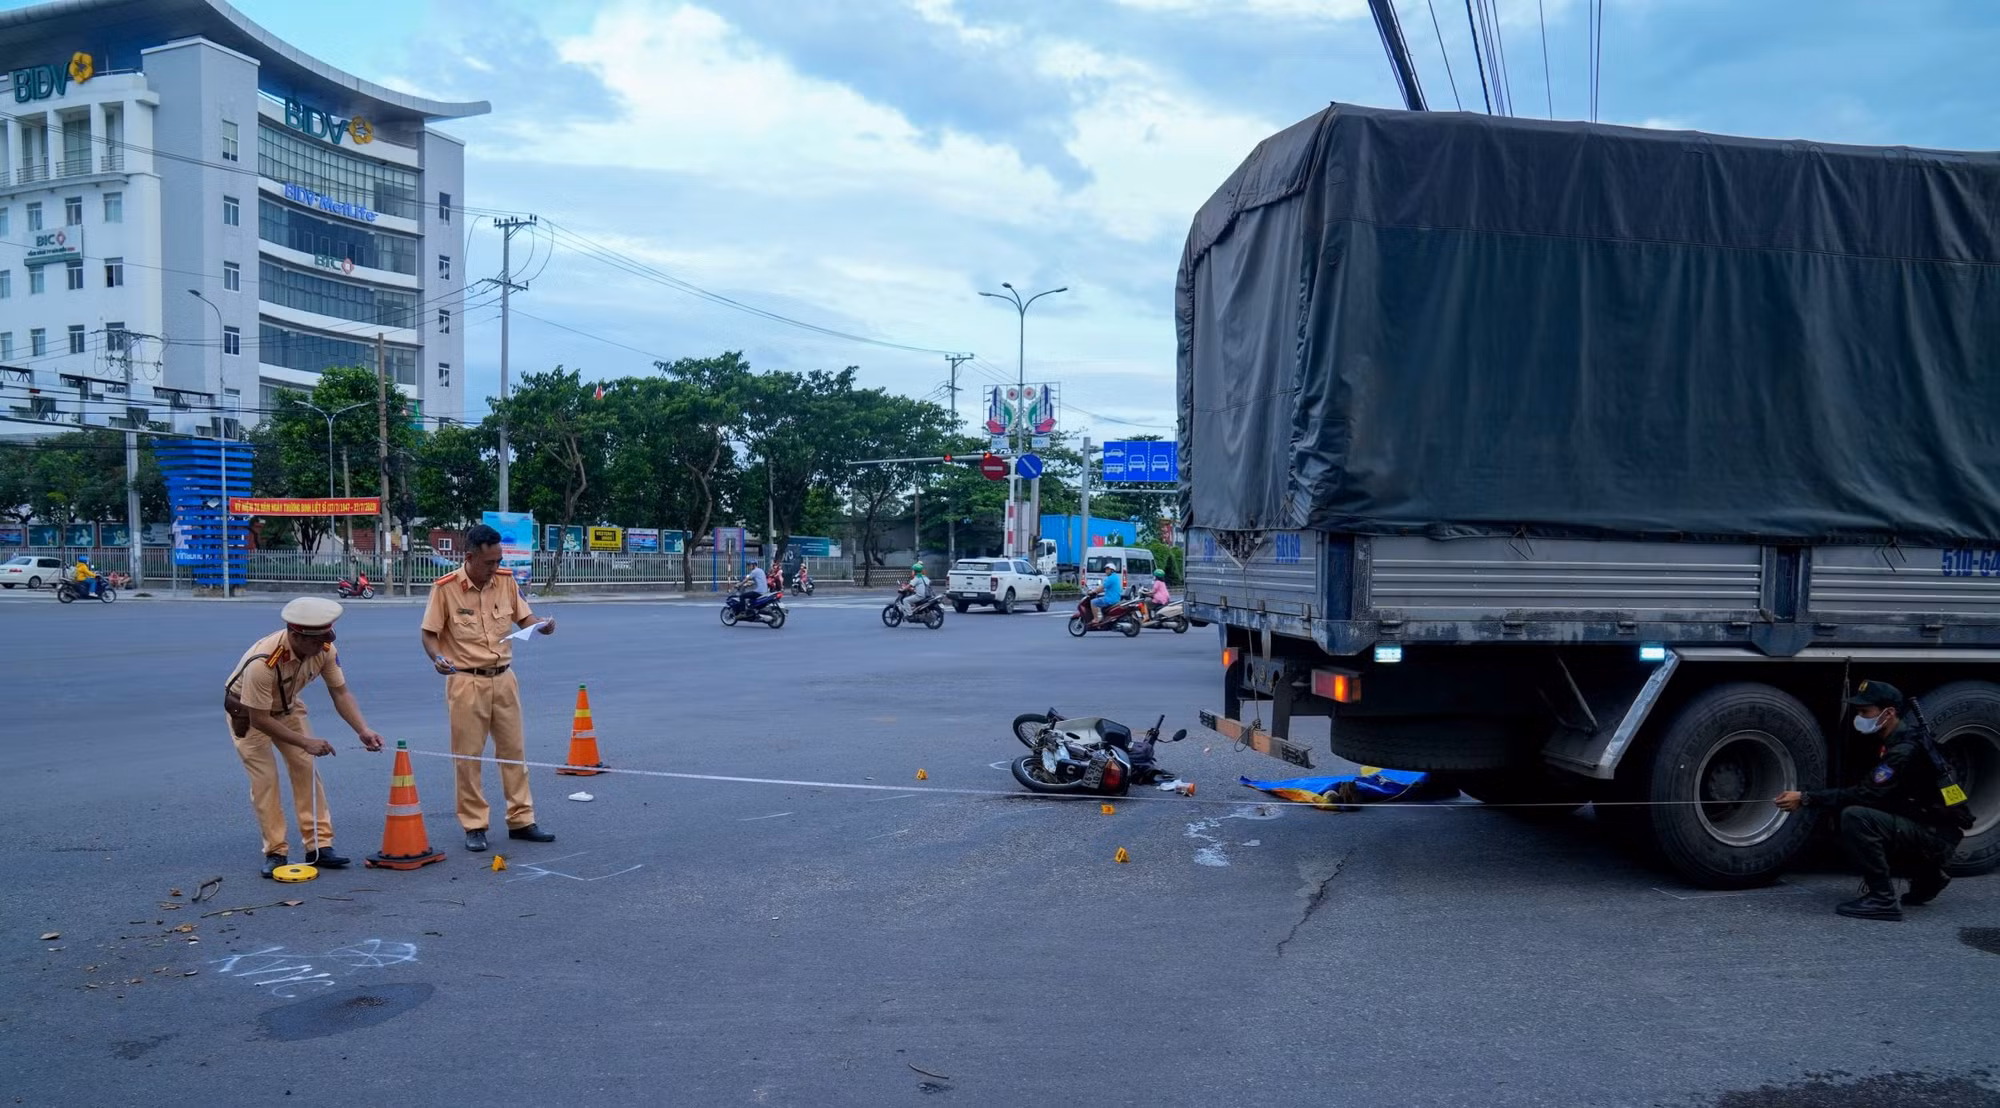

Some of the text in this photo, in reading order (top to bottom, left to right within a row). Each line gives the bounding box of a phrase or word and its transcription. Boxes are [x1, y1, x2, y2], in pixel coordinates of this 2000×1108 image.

[14, 61, 71, 103] BIDV
[285, 97, 349, 144] BIDV
[284, 183, 315, 206] BIDV
[36, 233, 56, 247] BIC
[315, 255, 344, 271] BIC
